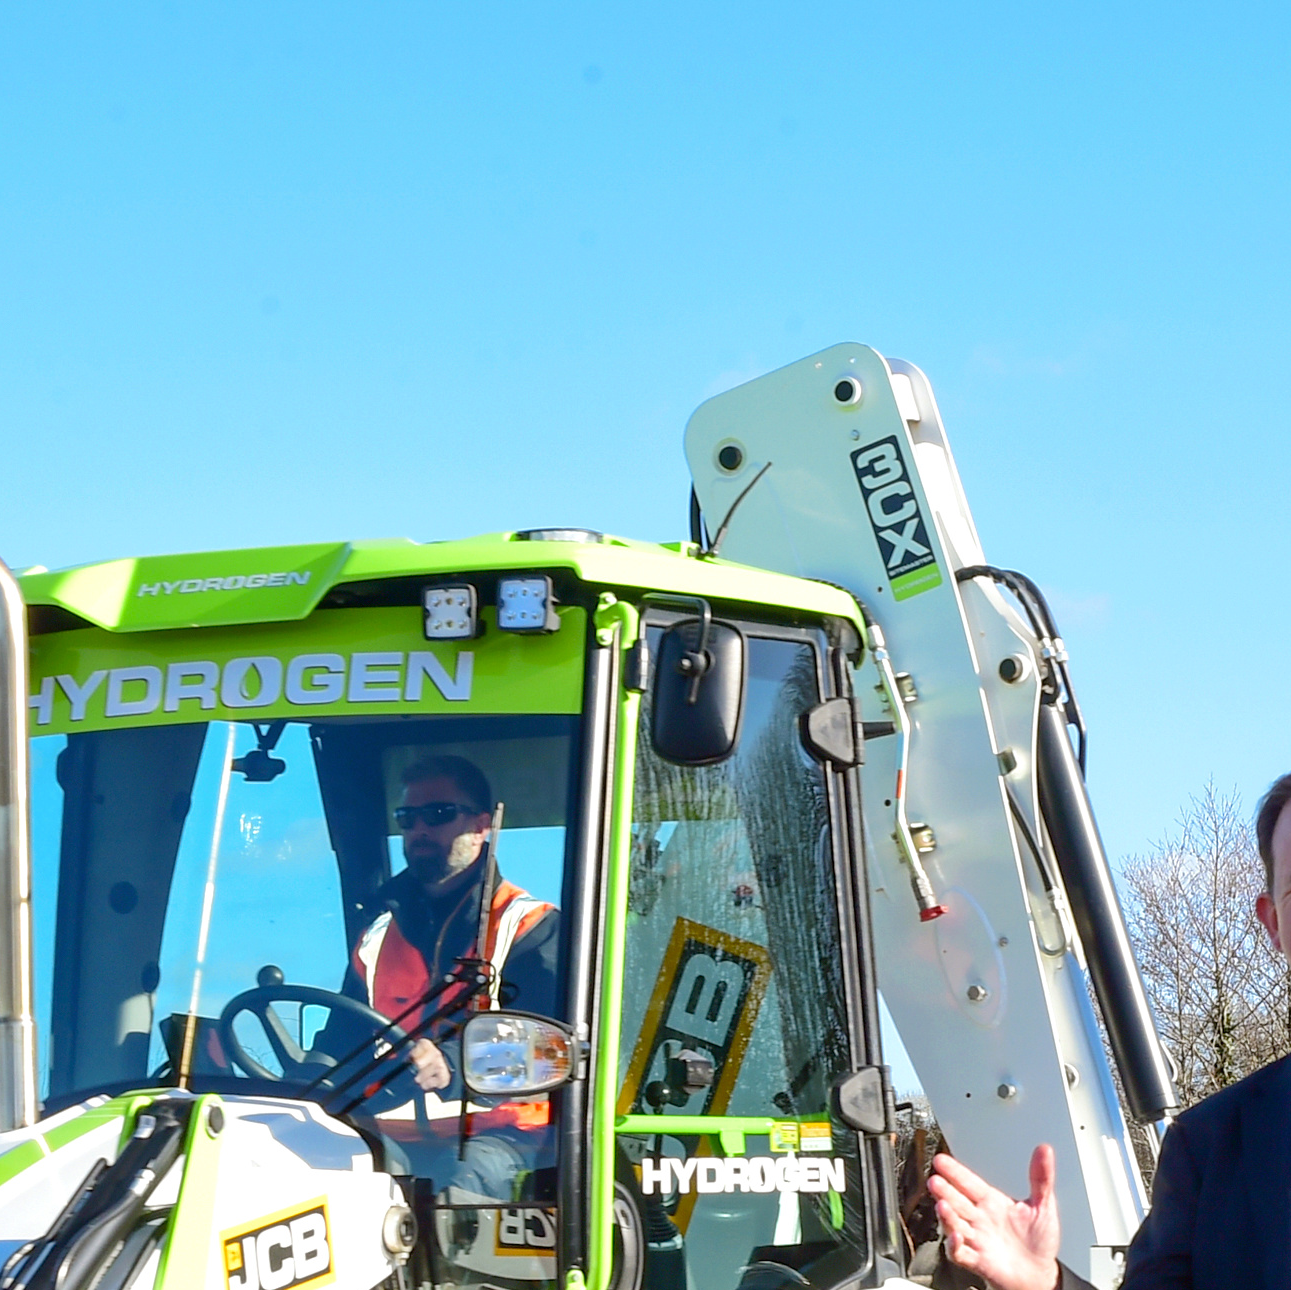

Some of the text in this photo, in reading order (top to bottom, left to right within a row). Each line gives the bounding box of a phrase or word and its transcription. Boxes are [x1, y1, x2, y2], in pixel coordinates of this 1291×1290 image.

[856, 442, 932, 570] 3CX
[136, 571, 311, 598] HYDROGEN
[641, 1157, 847, 1195] HYDROGEN
